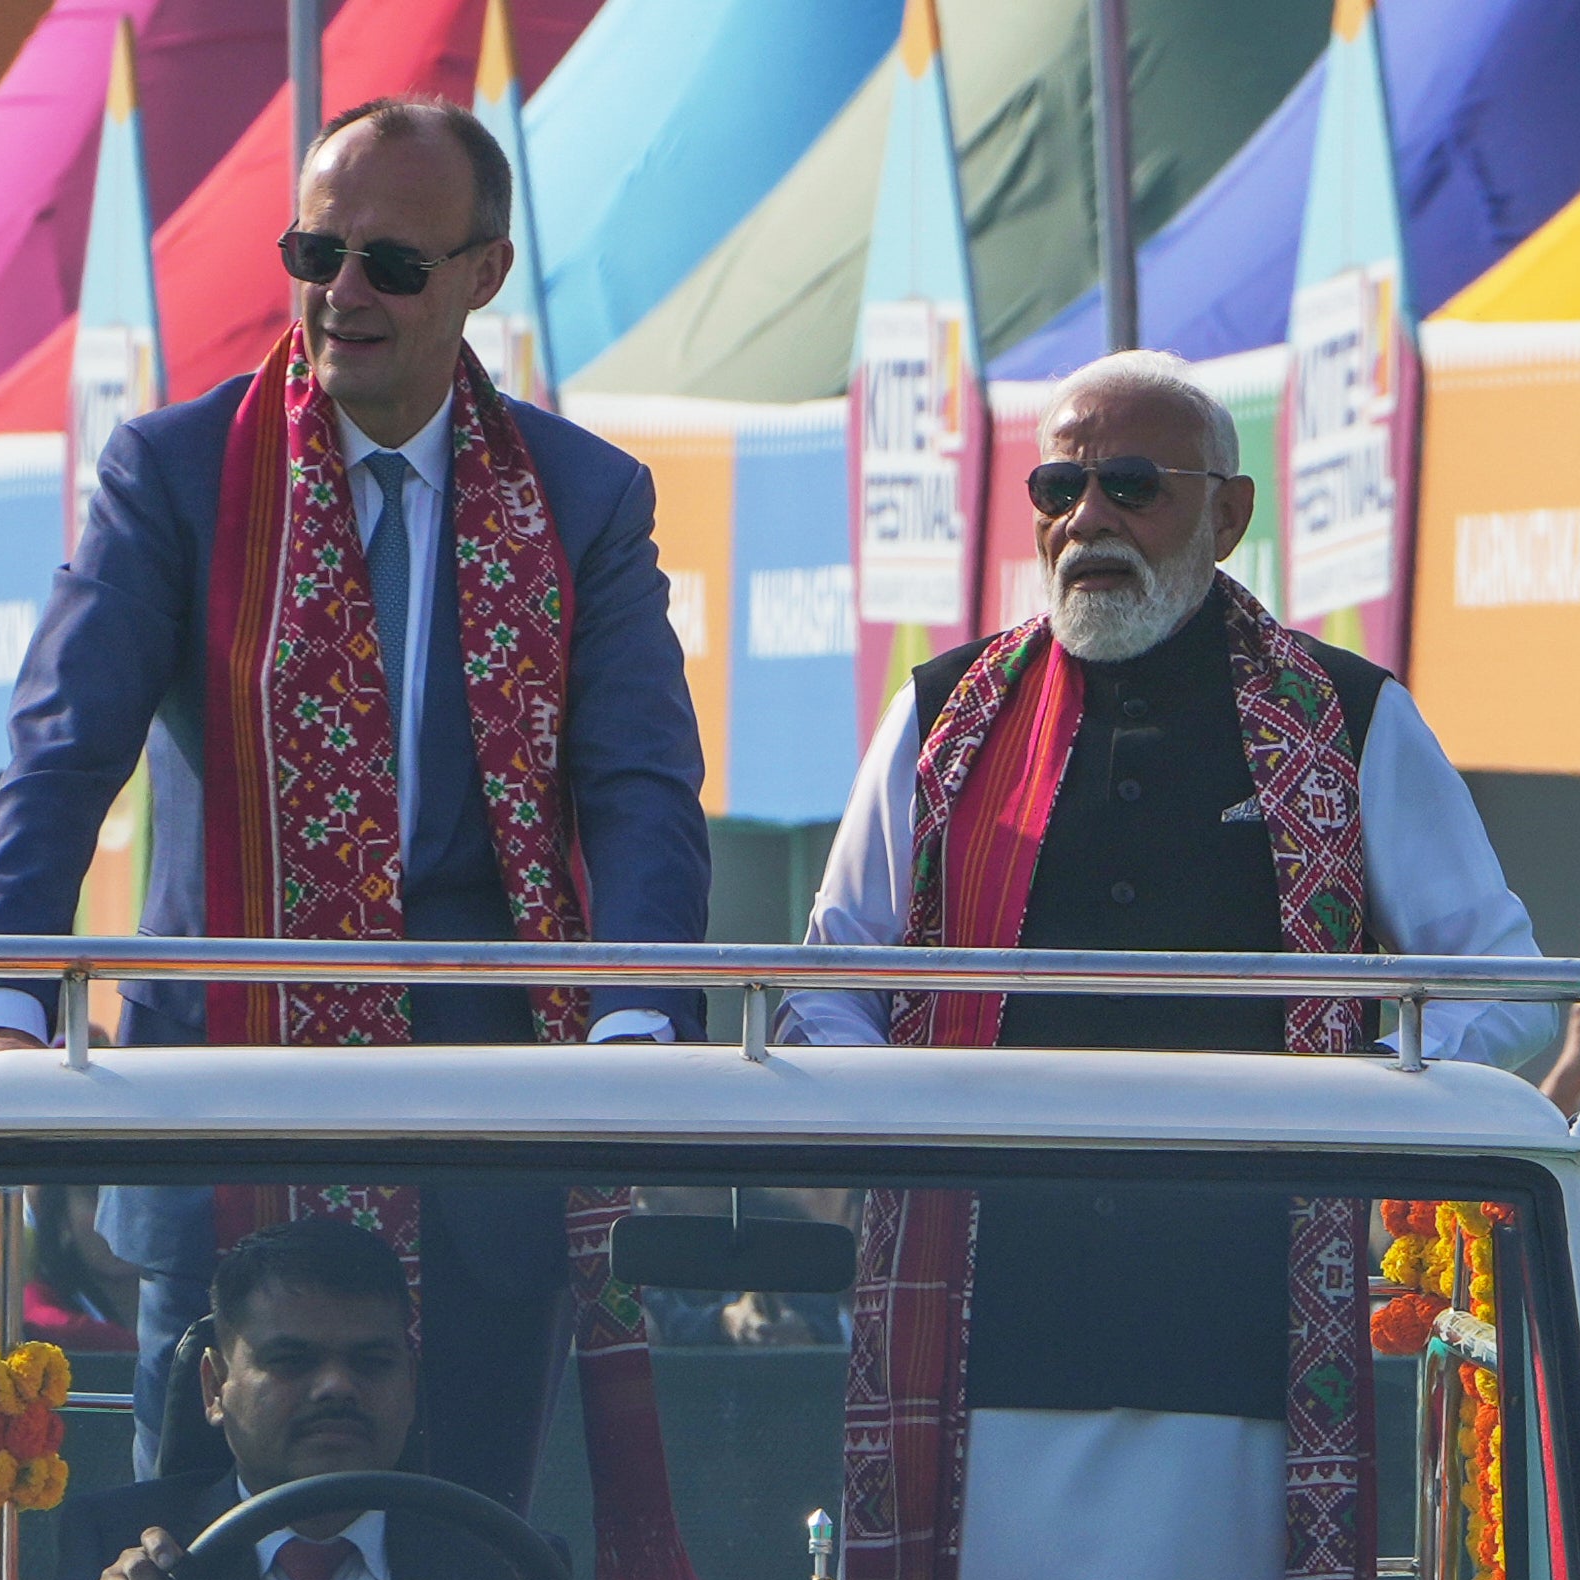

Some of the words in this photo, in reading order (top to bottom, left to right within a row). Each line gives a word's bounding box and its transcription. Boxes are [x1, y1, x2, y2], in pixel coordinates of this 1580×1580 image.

[864, 358, 927, 450] KITE
[1297, 329, 1359, 440] KITE
[864, 473, 960, 547] FESTIVAL
[1296, 438, 1395, 533] FESTIVAL
